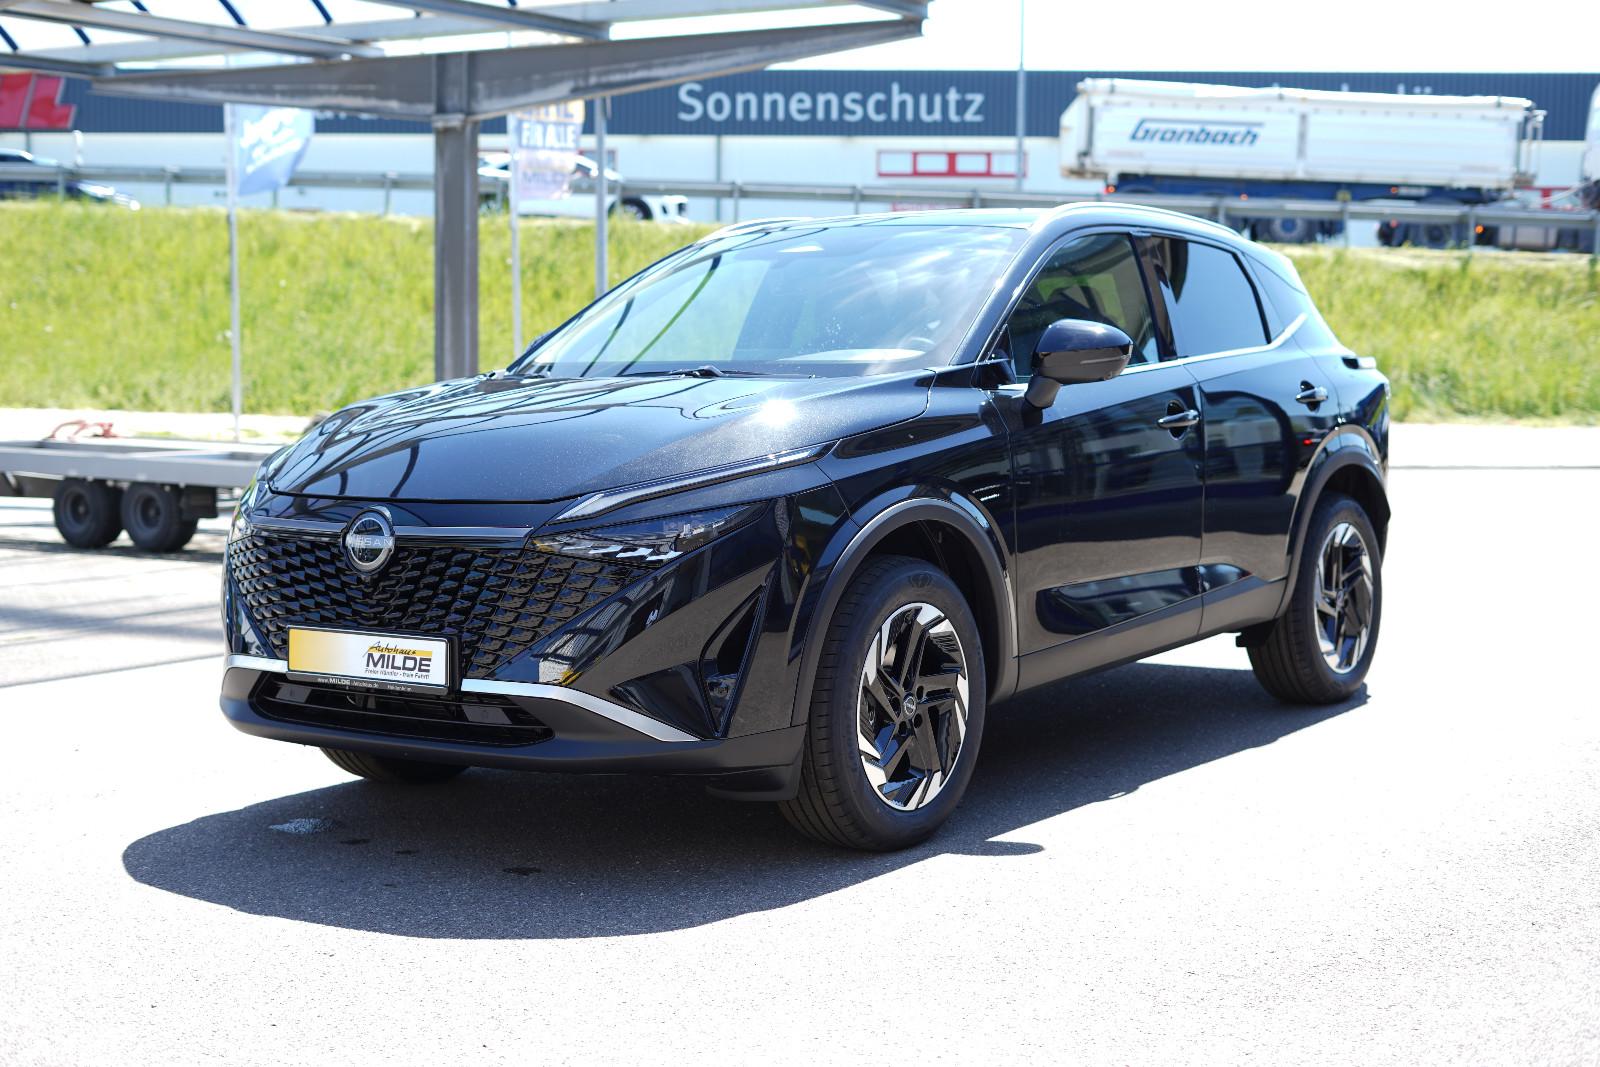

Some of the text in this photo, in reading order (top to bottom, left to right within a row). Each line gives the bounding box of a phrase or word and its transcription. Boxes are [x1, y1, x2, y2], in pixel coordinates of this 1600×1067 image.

[677, 82, 985, 123] Sonnenschutz
[1129, 118, 1264, 145] Gronbach
[347, 535, 394, 548] SSAN
[363, 641, 416, 656] Autohaus
[366, 653, 431, 673] MILDE
